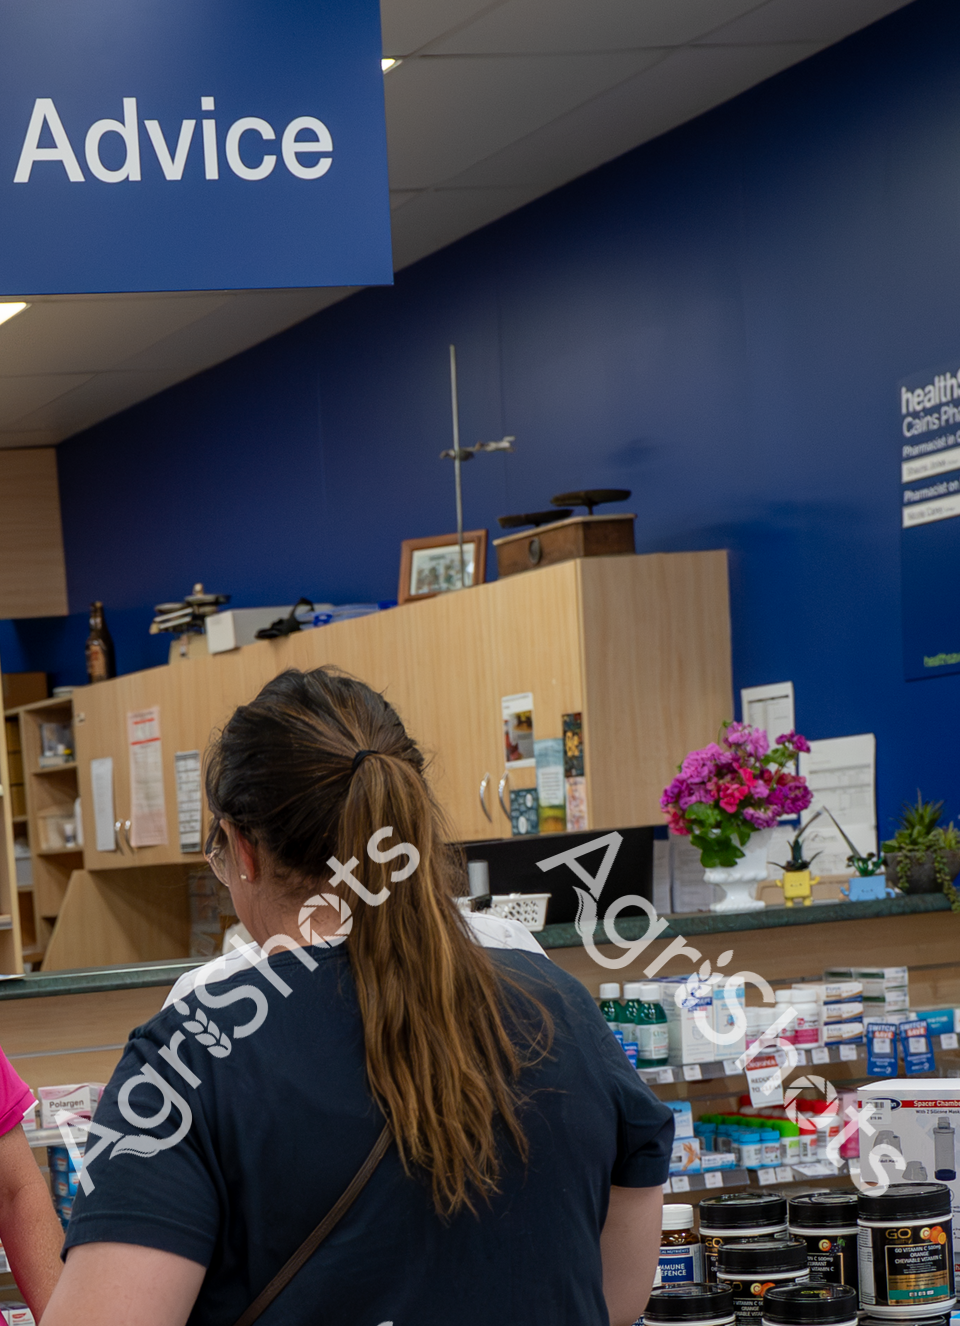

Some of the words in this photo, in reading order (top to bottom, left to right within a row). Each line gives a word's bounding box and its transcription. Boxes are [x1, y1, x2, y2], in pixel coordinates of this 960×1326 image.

[14, 97, 333, 183] Advice
[901, 369, 960, 415] health
[49, 1099, 84, 1108] Polargen
[885, 1228, 911, 1239] GO
